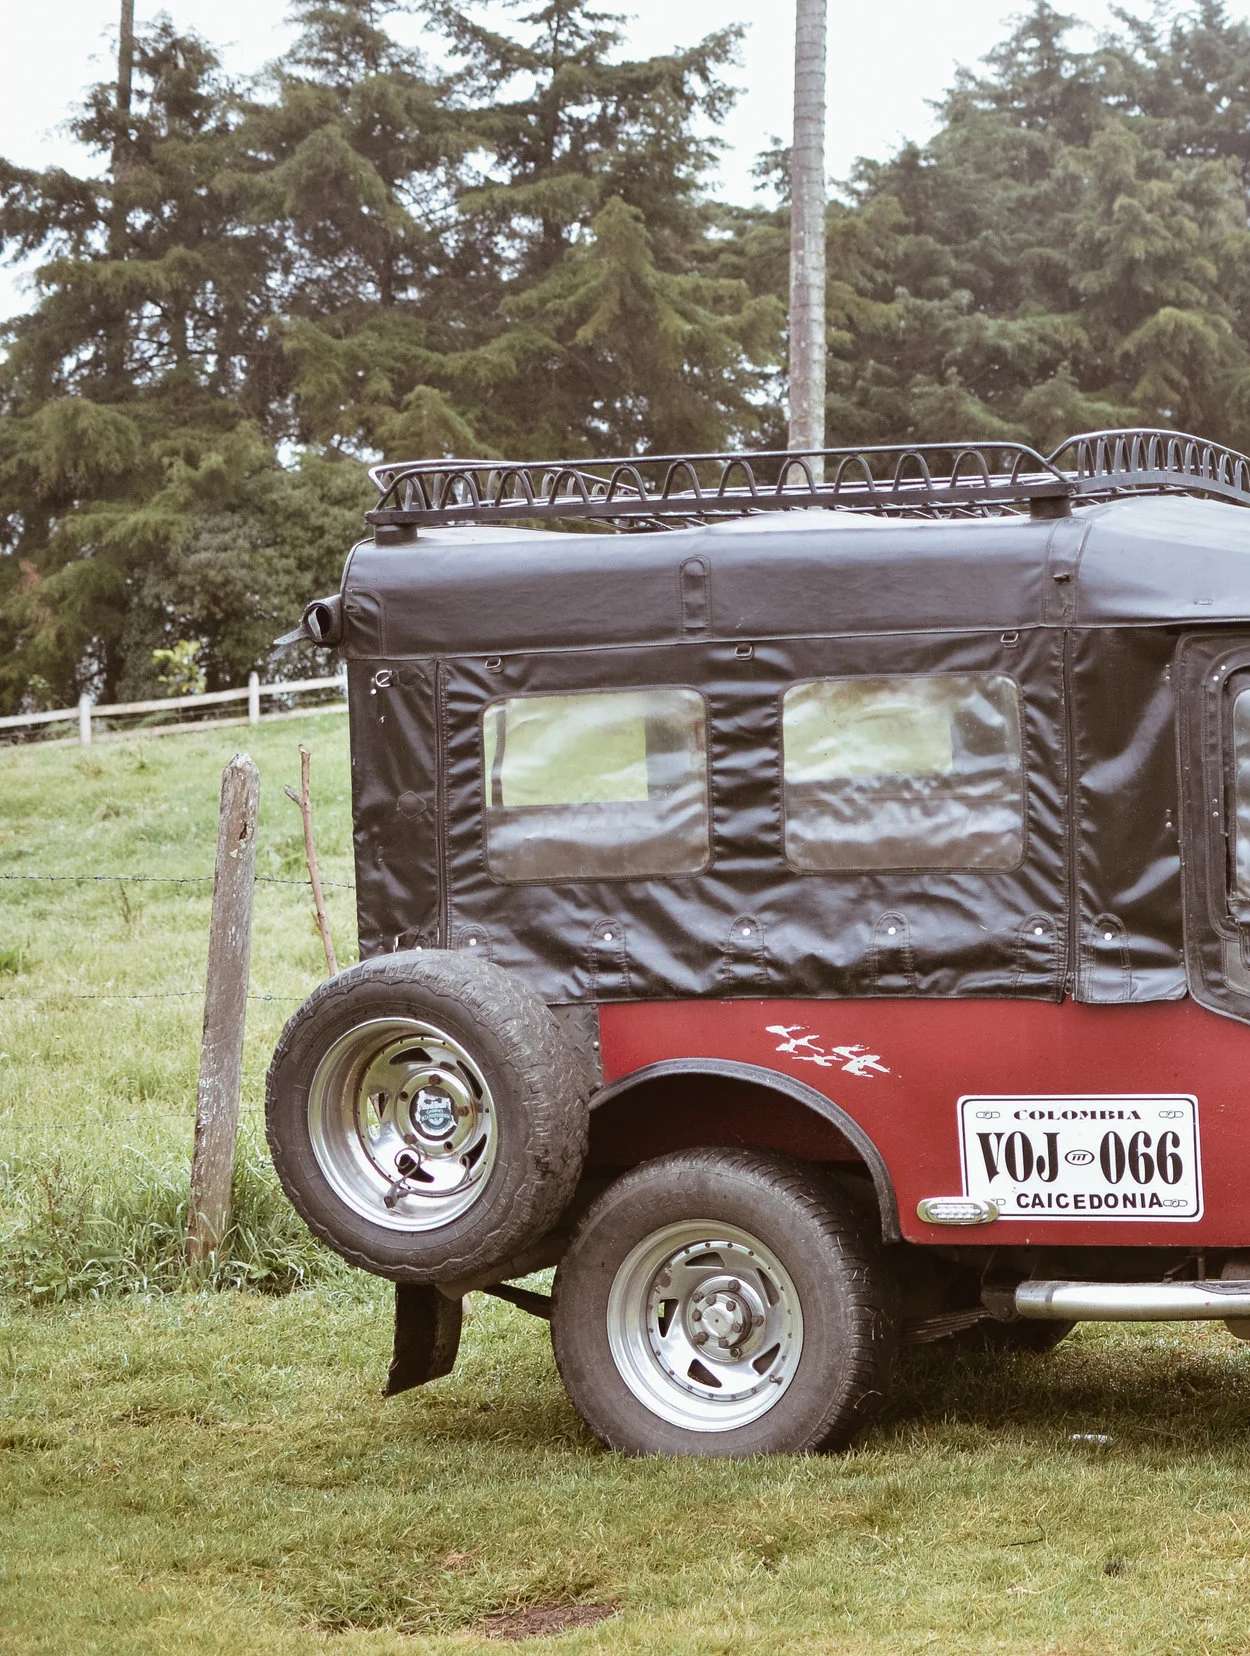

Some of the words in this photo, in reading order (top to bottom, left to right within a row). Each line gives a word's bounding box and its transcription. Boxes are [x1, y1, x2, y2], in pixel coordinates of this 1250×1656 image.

[1013, 1109, 1142, 1121] COLOMBIA
[976, 1130, 1060, 1184] VOJ
[1100, 1130, 1184, 1185] 066
[1016, 1192, 1163, 1210] CAICEDONIA
